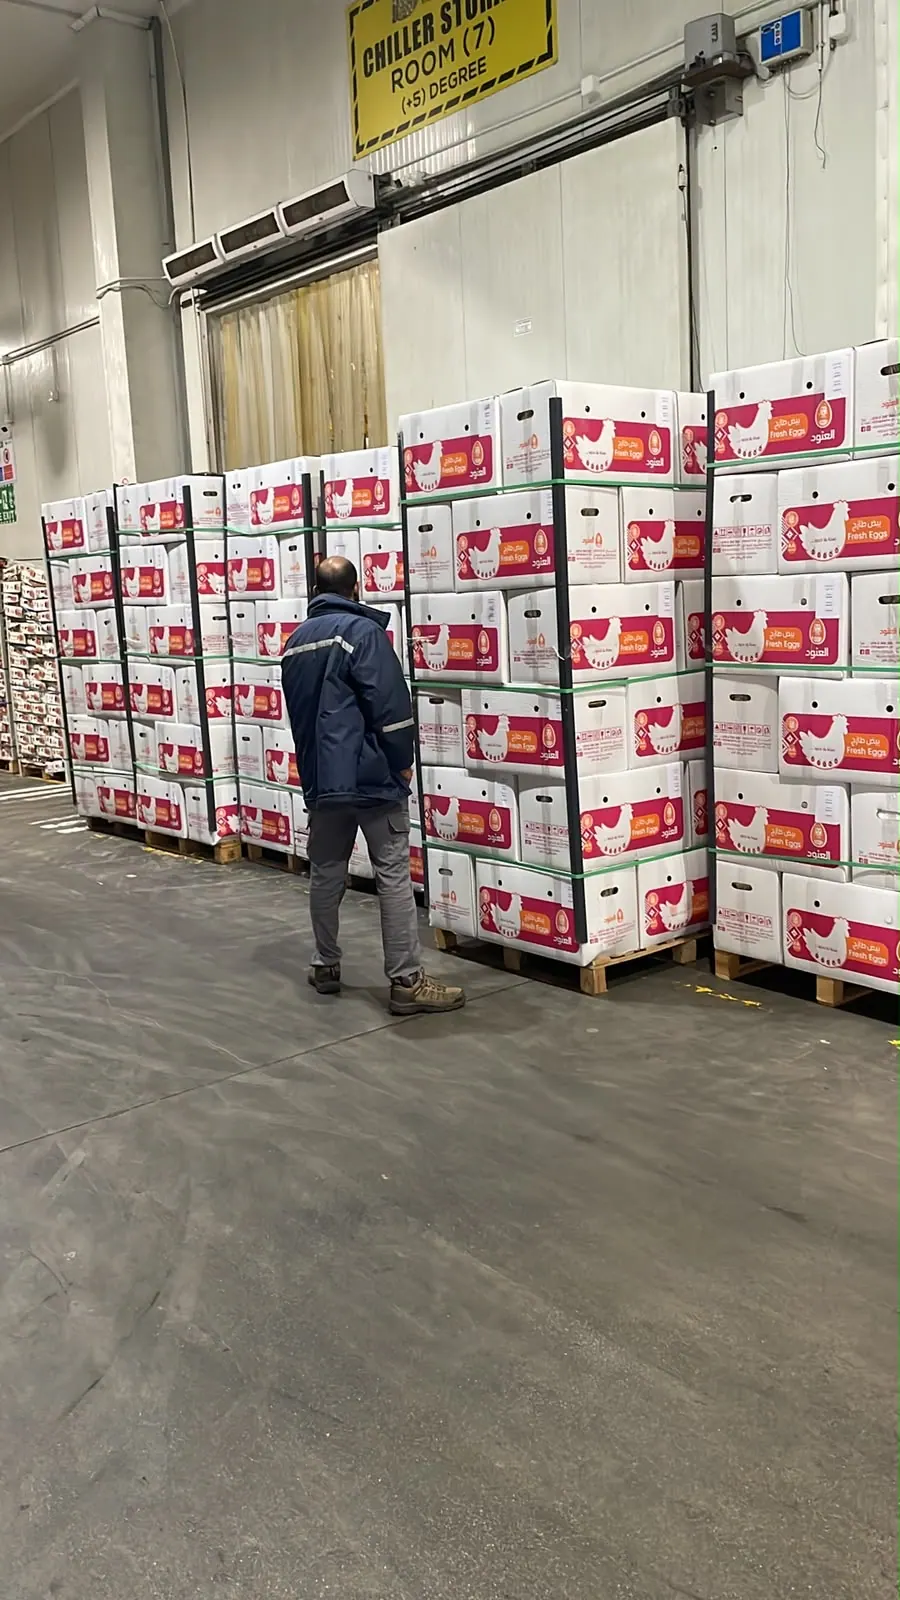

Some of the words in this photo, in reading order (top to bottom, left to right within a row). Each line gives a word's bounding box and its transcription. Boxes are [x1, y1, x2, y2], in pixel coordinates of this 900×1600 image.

[363, 13, 434, 78] CHILLER
[392, 38, 454, 93] ROOM
[463, 15, 495, 57] (7)
[401, 87, 425, 115] (+5)
[430, 56, 487, 100] DEGREE
[770, 429, 787, 438] Fresh
[789, 428, 805, 437] Eggs
[810, 429, 835, 444] العنود
[848, 532, 867, 540] Fresh
[869, 531, 887, 540] Eggs
[766, 640, 782, 648] Fresh
[784, 640, 800, 649] Eggs
[805, 648, 828, 659] العنود
[847, 746, 866, 755] Fresh
[868, 748, 886, 757] Eggs
[767, 836, 784, 845] Fresh
[785, 839, 802, 848] Eggs
[849, 950, 868, 960] Fresh
[870, 954, 887, 964] Eggs
